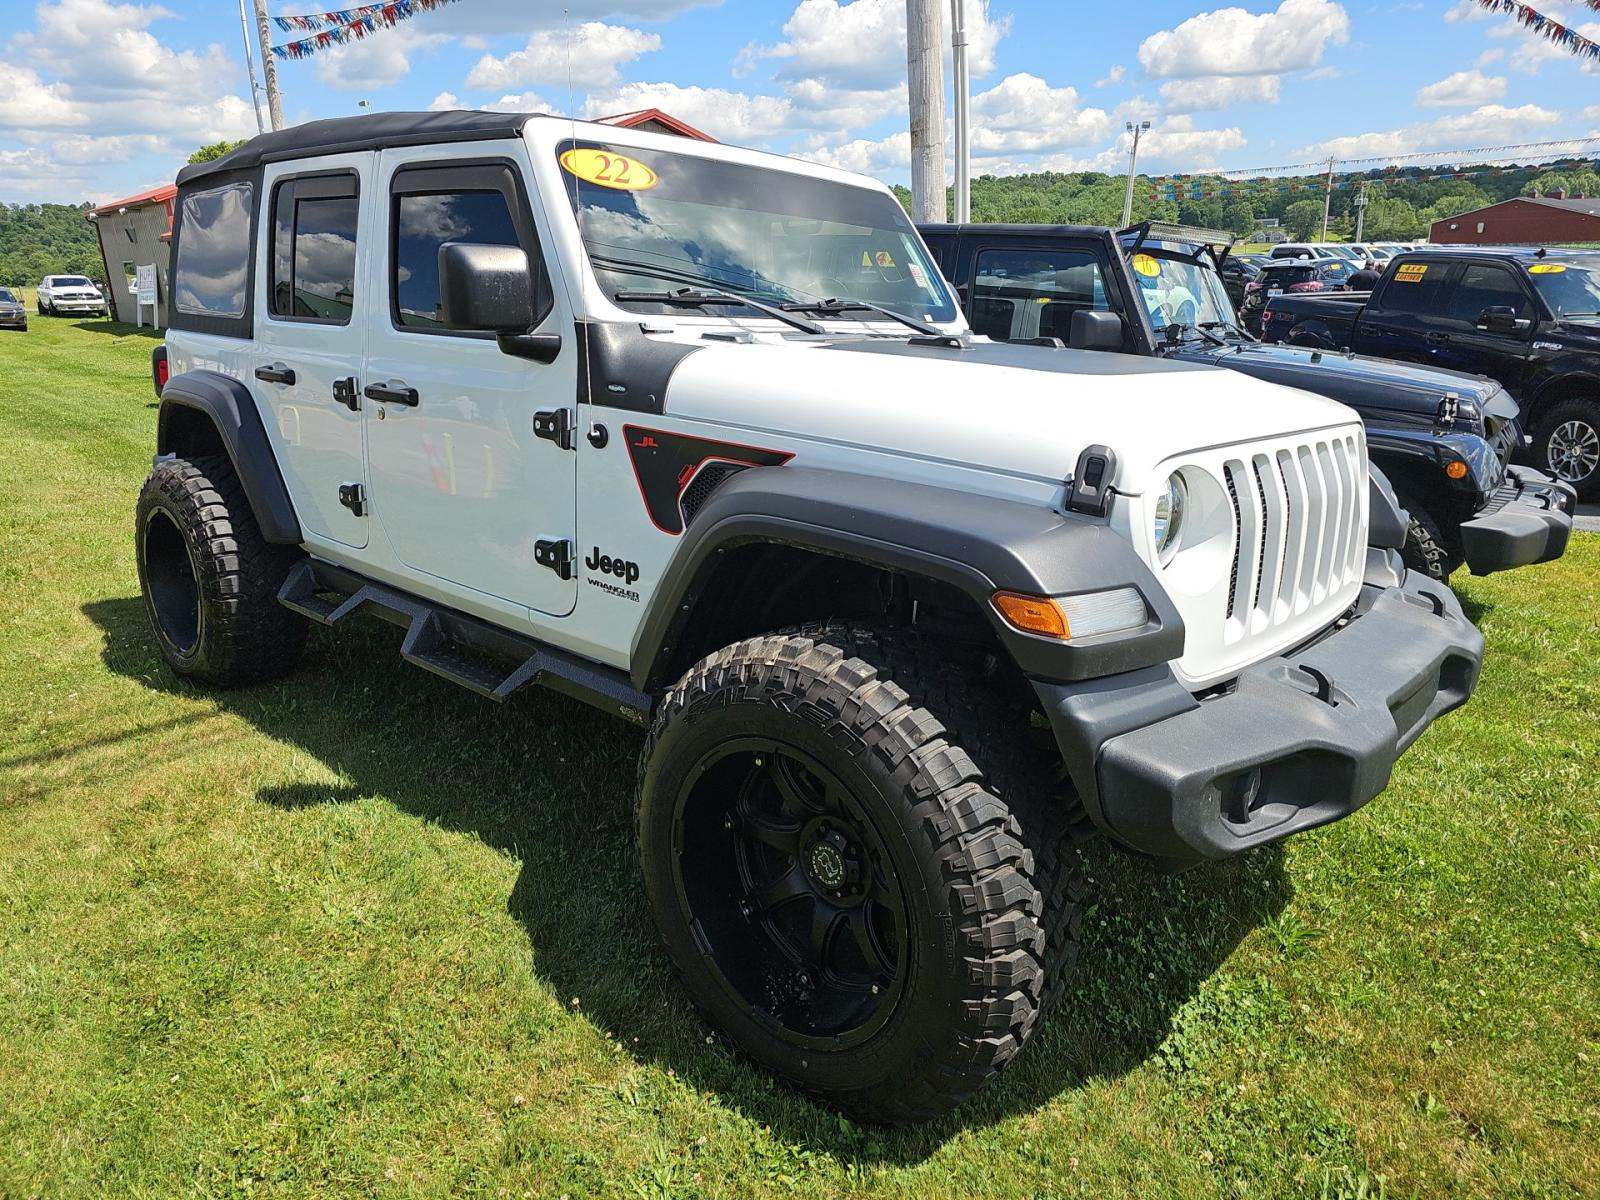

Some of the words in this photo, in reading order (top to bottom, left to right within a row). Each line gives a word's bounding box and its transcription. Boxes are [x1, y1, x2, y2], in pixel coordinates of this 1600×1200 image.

[594, 154, 630, 183] 22
[585, 546, 640, 585] Jeep
[587, 577, 640, 600] WRANGLER
